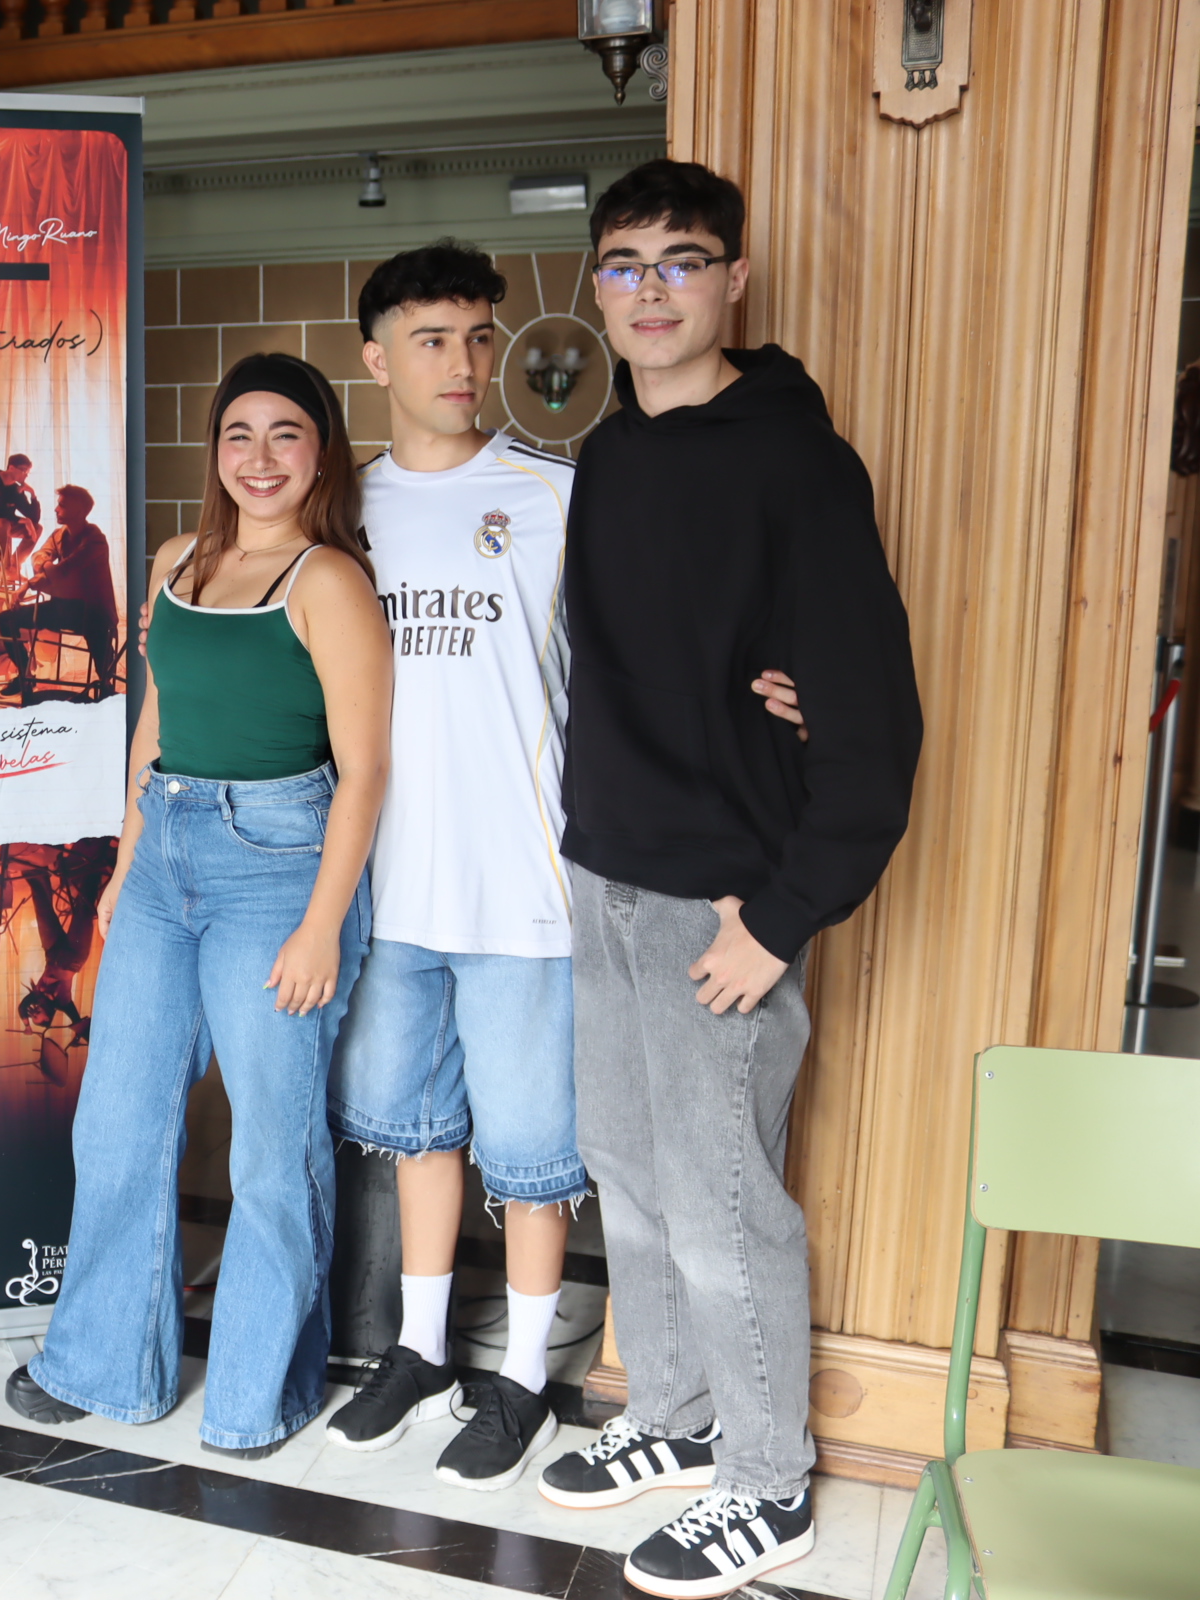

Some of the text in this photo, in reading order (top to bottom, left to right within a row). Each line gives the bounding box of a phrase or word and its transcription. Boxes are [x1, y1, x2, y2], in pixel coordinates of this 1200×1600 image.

[39, 217, 98, 246] Ruano
[377, 581, 504, 623] mirates
[400, 625, 476, 657] BETTER
[0, 716, 79, 747] sistema.
[42, 1245, 69, 1257] TEAT
[42, 1257, 67, 1269] PÉR
